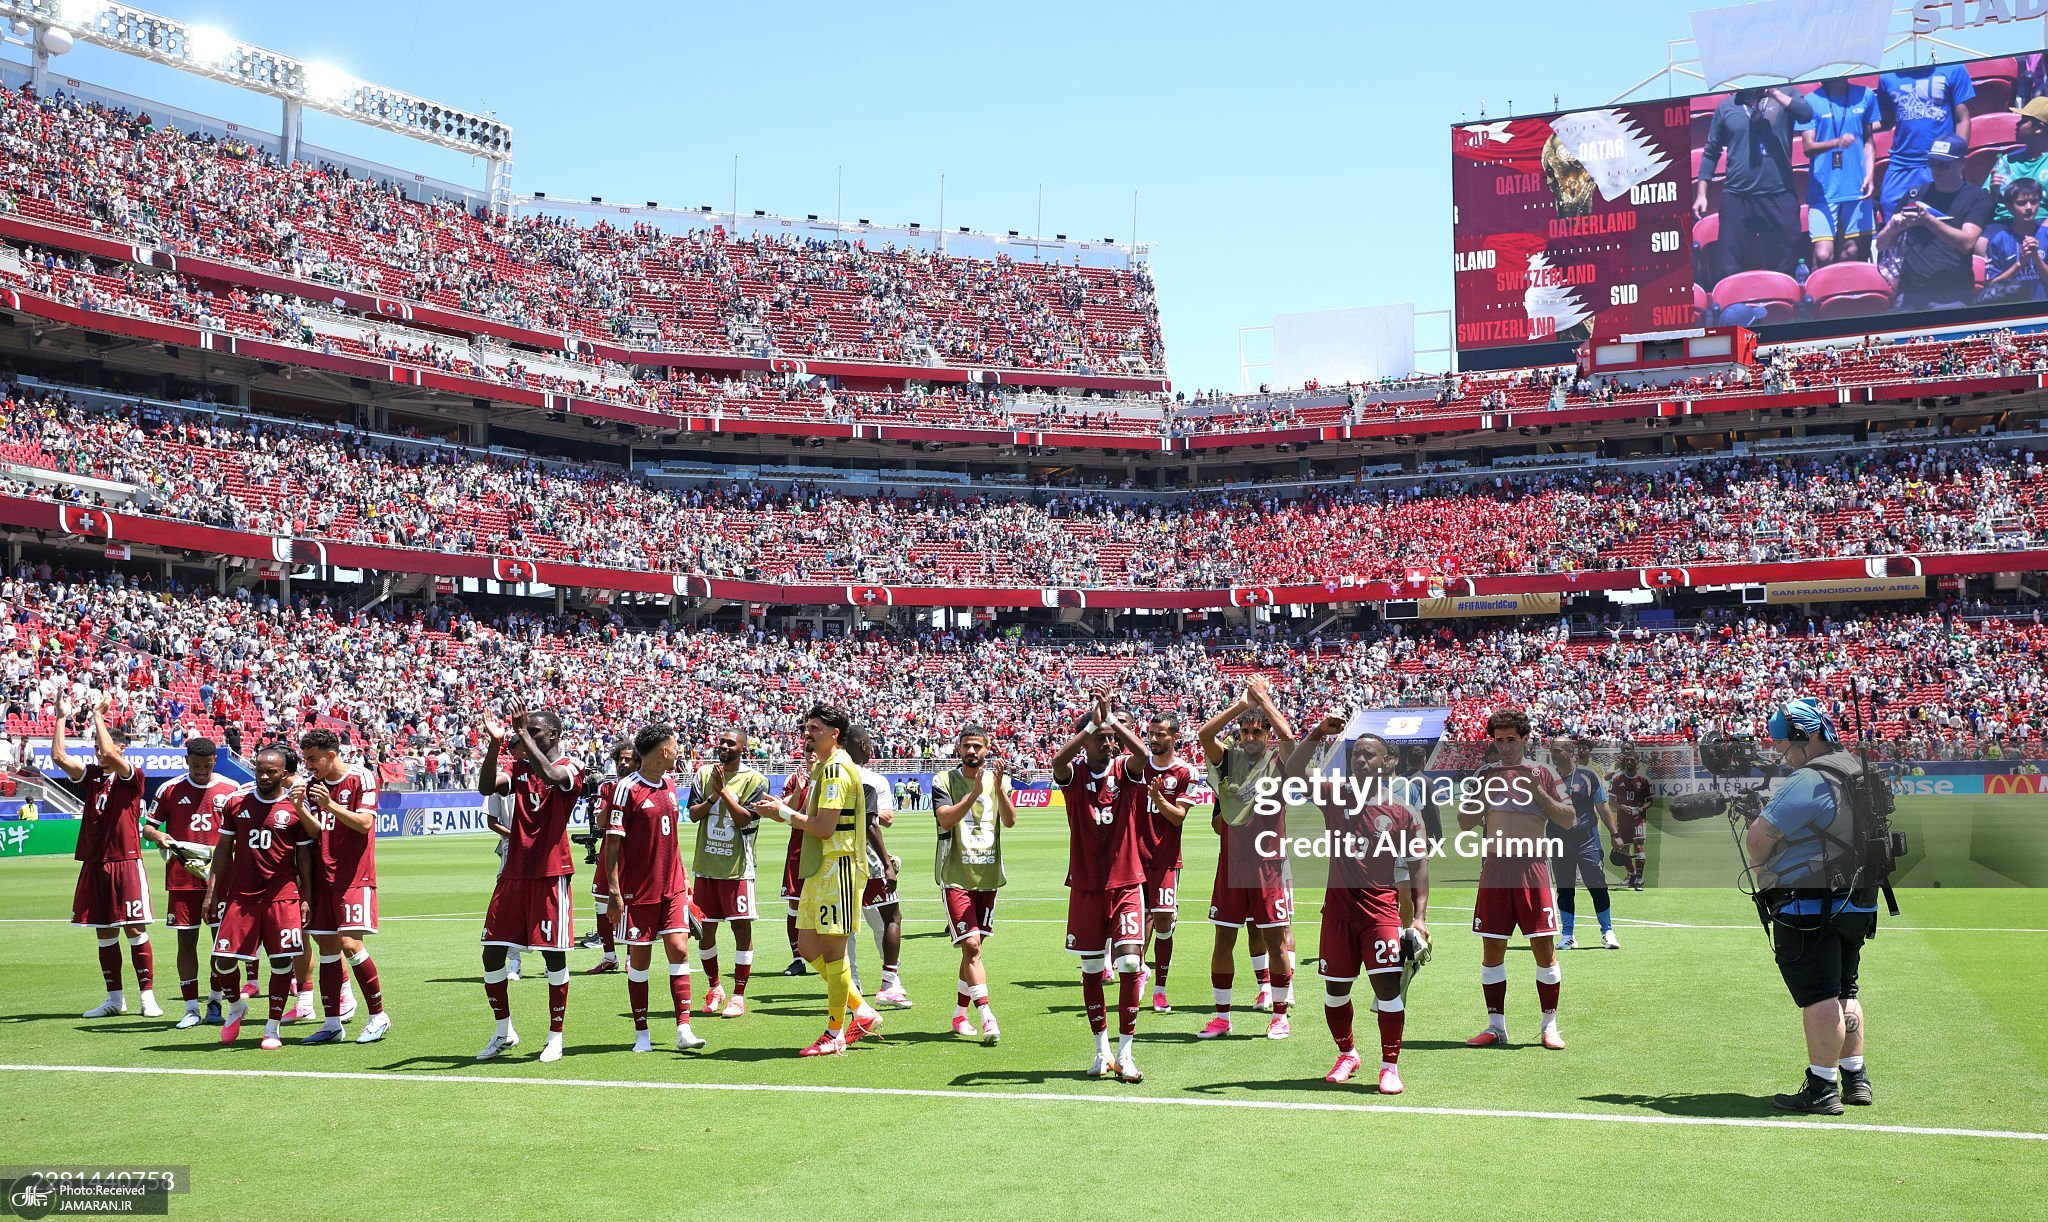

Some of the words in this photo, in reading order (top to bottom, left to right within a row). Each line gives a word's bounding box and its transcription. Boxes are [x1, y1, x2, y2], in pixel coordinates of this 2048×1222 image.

[1579, 139, 1625, 161] QATAR
[1496, 172, 1541, 195] QATAR
[1630, 182, 1678, 206] QATAR
[1496, 264, 1597, 292] SWITZERLAND
[1457, 316, 1556, 343] SWITZERLAND
[1772, 589, 1795, 597] SAN
[1796, 587, 1861, 596] FRANCISCO
[1864, 585, 1886, 593] BAY
[1888, 584, 1920, 592] AREA
[1457, 600, 1518, 611] #FIFAWorldCup
[1626, 790, 1636, 801] 10
[190, 813, 213, 833] 25
[660, 815, 671, 837] 8
[711, 829, 727, 838] FIFA
[248, 829, 272, 850] 20
[1158, 887, 1174, 906] 16
[126, 900, 143, 918] 12
[344, 904, 364, 924] 13
[819, 904, 838, 926] 21
[541, 920, 552, 942] 4
[1119, 911, 1140, 936] 15
[280, 928, 301, 950] 20
[1374, 940, 1400, 964] 23
